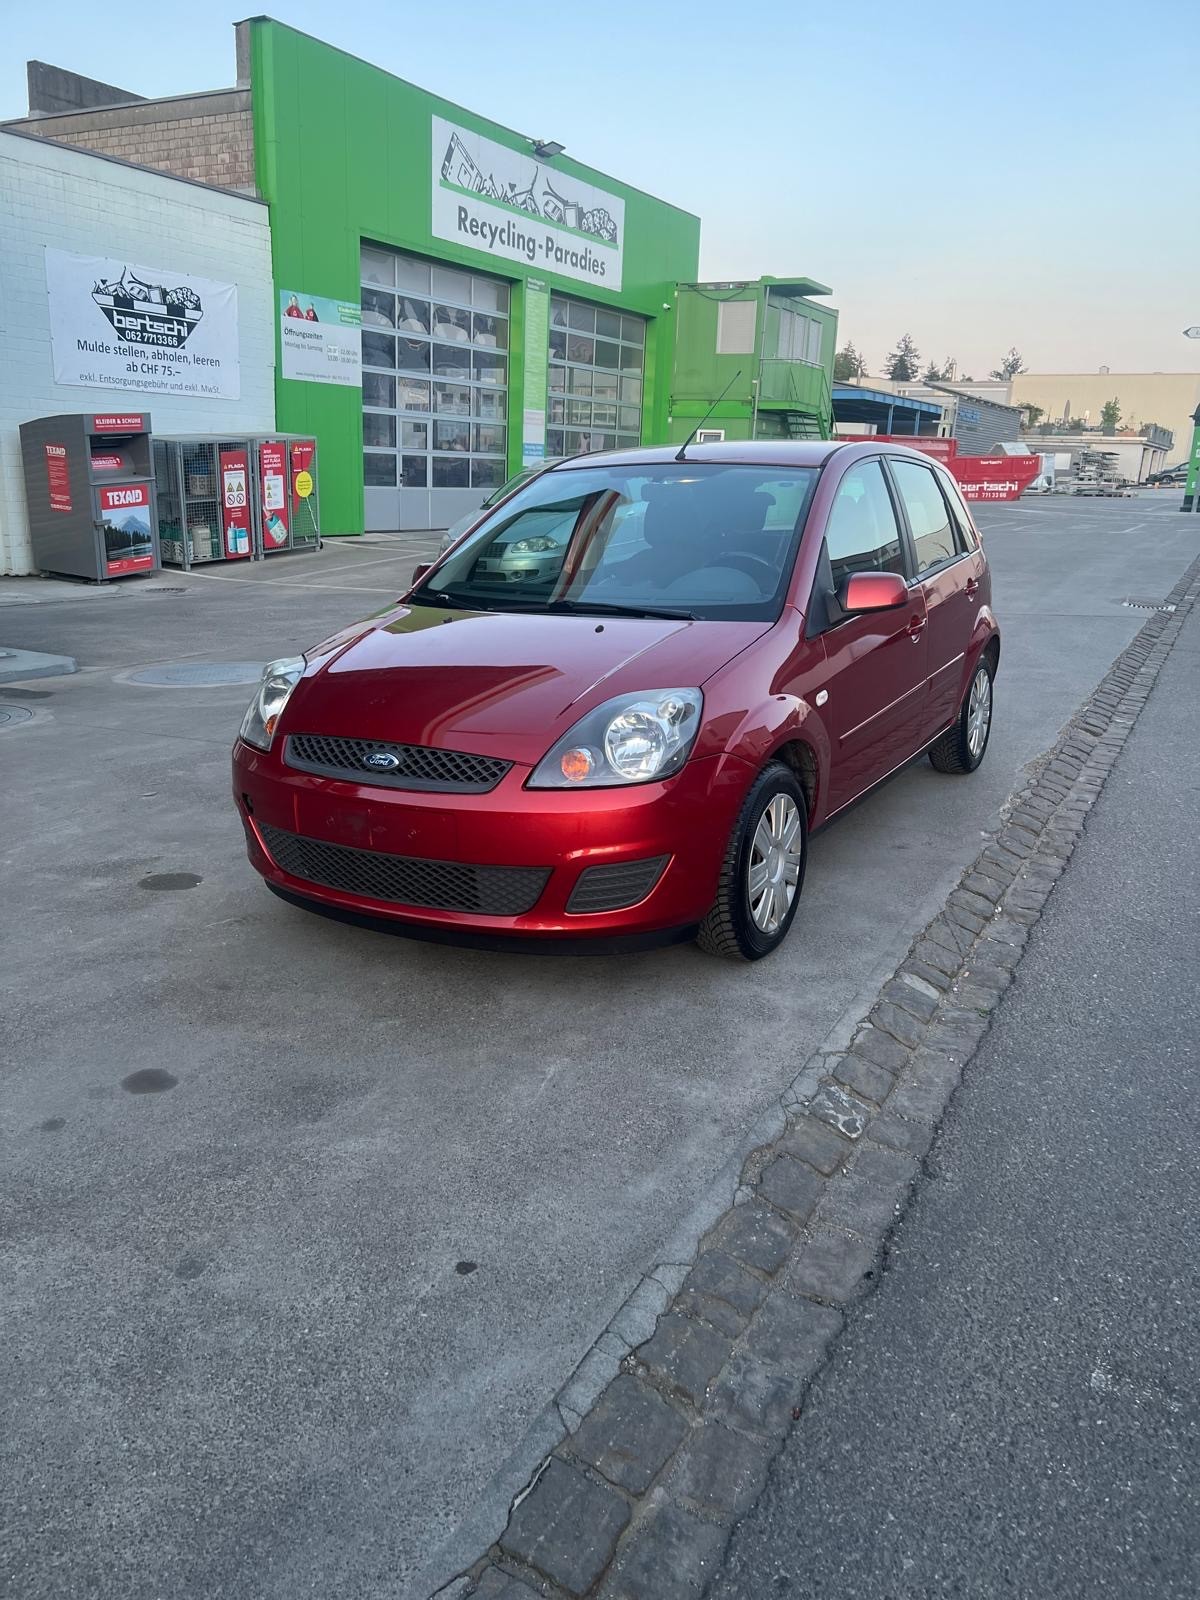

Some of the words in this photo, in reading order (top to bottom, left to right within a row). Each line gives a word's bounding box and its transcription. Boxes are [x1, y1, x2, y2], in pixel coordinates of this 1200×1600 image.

[457, 205, 606, 276] Recycling-Paradies
[112, 310, 188, 337] bertschi
[125, 330, 141, 341] 062
[143, 333, 178, 346] 7713366
[284, 326, 323, 340] Öffnungszeiten
[77, 340, 111, 354] Mulde
[113, 345, 149, 360] stellen,
[151, 350, 191, 365] abholen,
[193, 354, 220, 367] leeren
[126, 362, 138, 373] ab
[140, 363, 159, 375] CHF
[80, 373, 98, 382] exkl.
[99, 374, 169, 390] Entsorgungsgebühr
[170, 382, 183, 391] und
[184, 383, 200, 392] exkl.
[201, 384, 221, 394] MwSt.
[46, 445, 66, 455] TEXAID
[959, 481, 1018, 492] bertschi
[106, 489, 143, 506] TEXAID
[369, 753, 390, 766] Ford
